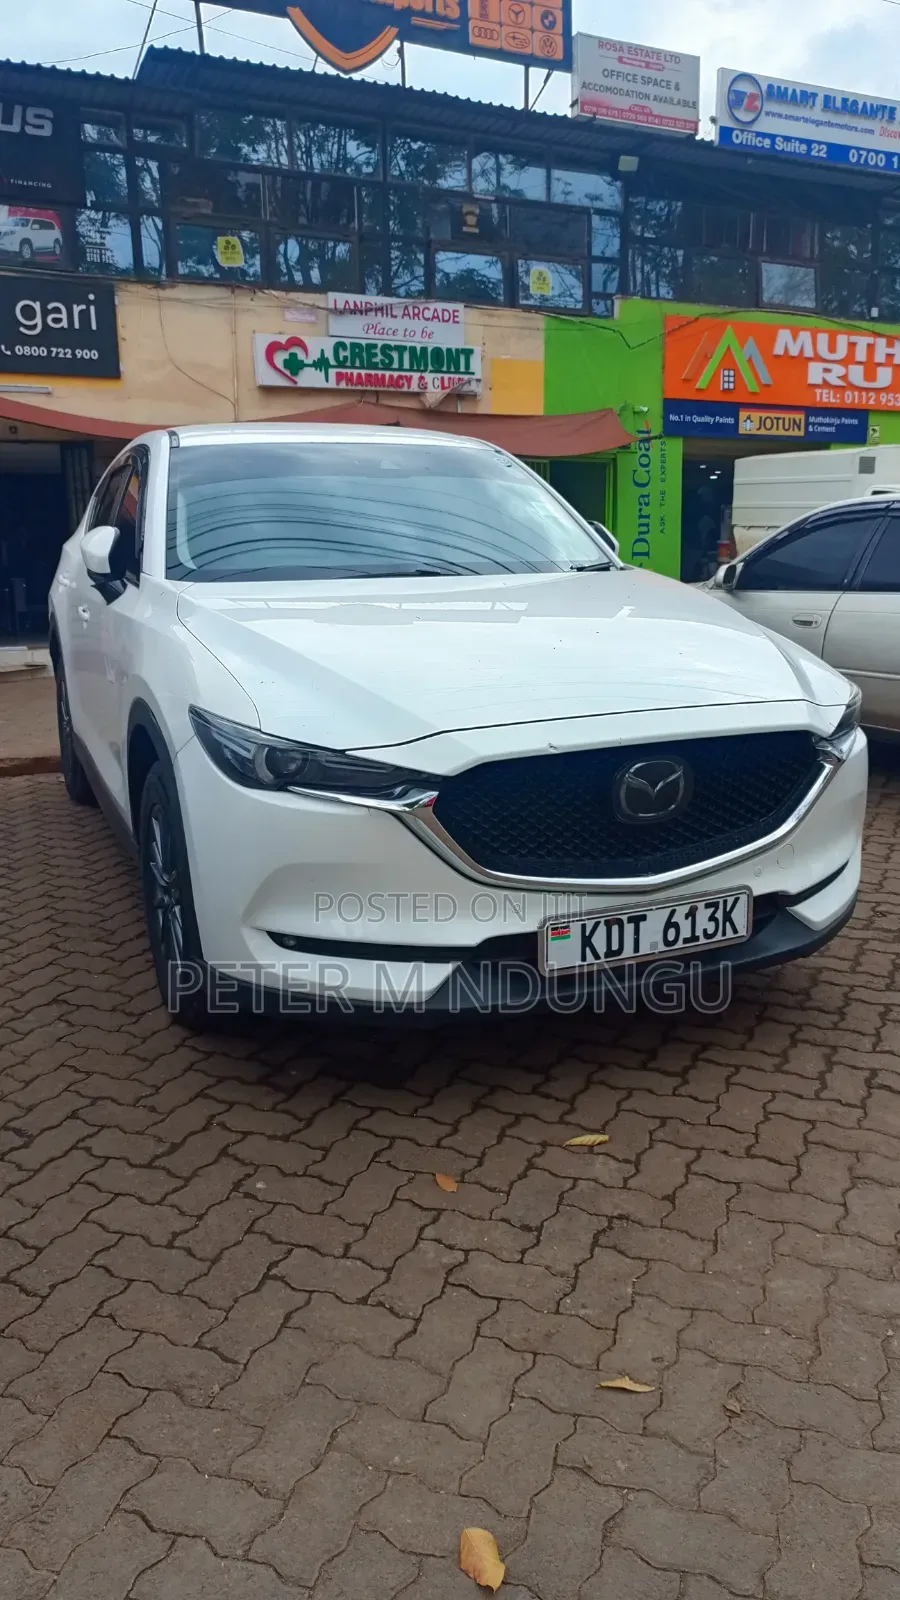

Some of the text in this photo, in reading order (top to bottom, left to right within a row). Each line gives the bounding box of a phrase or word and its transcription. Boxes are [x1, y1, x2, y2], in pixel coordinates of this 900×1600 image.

[598, 40, 681, 65] ROSA ESTATE LTD
[602, 68, 680, 91] OFFICE SPACE &
[581, 80, 697, 110] ACCOMODATION AVAILABLE
[765, 83, 818, 109] SMART
[823, 94, 896, 122] ELEGANTE
[764, 109, 875, 136] www.smartelegantemotors.com
[732, 129, 771, 148] Office
[775, 136, 808, 154] Suite
[811, 143, 828, 158] 22
[849, 148, 886, 167] 0700
[10, 178, 52, 189] FINANCING
[15, 293, 97, 336] gari
[333, 298, 460, 324] LANPHIL ARCADE
[362, 322, 435, 340] Place to be
[15, 345, 99, 360] 0800 722 900
[333, 340, 474, 372] CRESTMONT
[773, 329, 900, 365] MUTH
[335, 371, 414, 390] PHARMACY
[417, 373, 428, 390] &
[808, 362, 893, 388] RU
[815, 388, 840, 403] TEL:
[844, 390, 876, 405] 0112
[669, 414, 684, 422] No.1
[692, 415, 714, 425] Quality
[715, 416, 735, 424] Paints
[756, 415, 802, 432] JOTUN
[814, 425, 836, 433] Cement
[841, 417, 859, 425] Paints
[632, 428, 651, 560] Dura Coat
[580, 913, 648, 963] KDT
[662, 896, 741, 948] 613K
